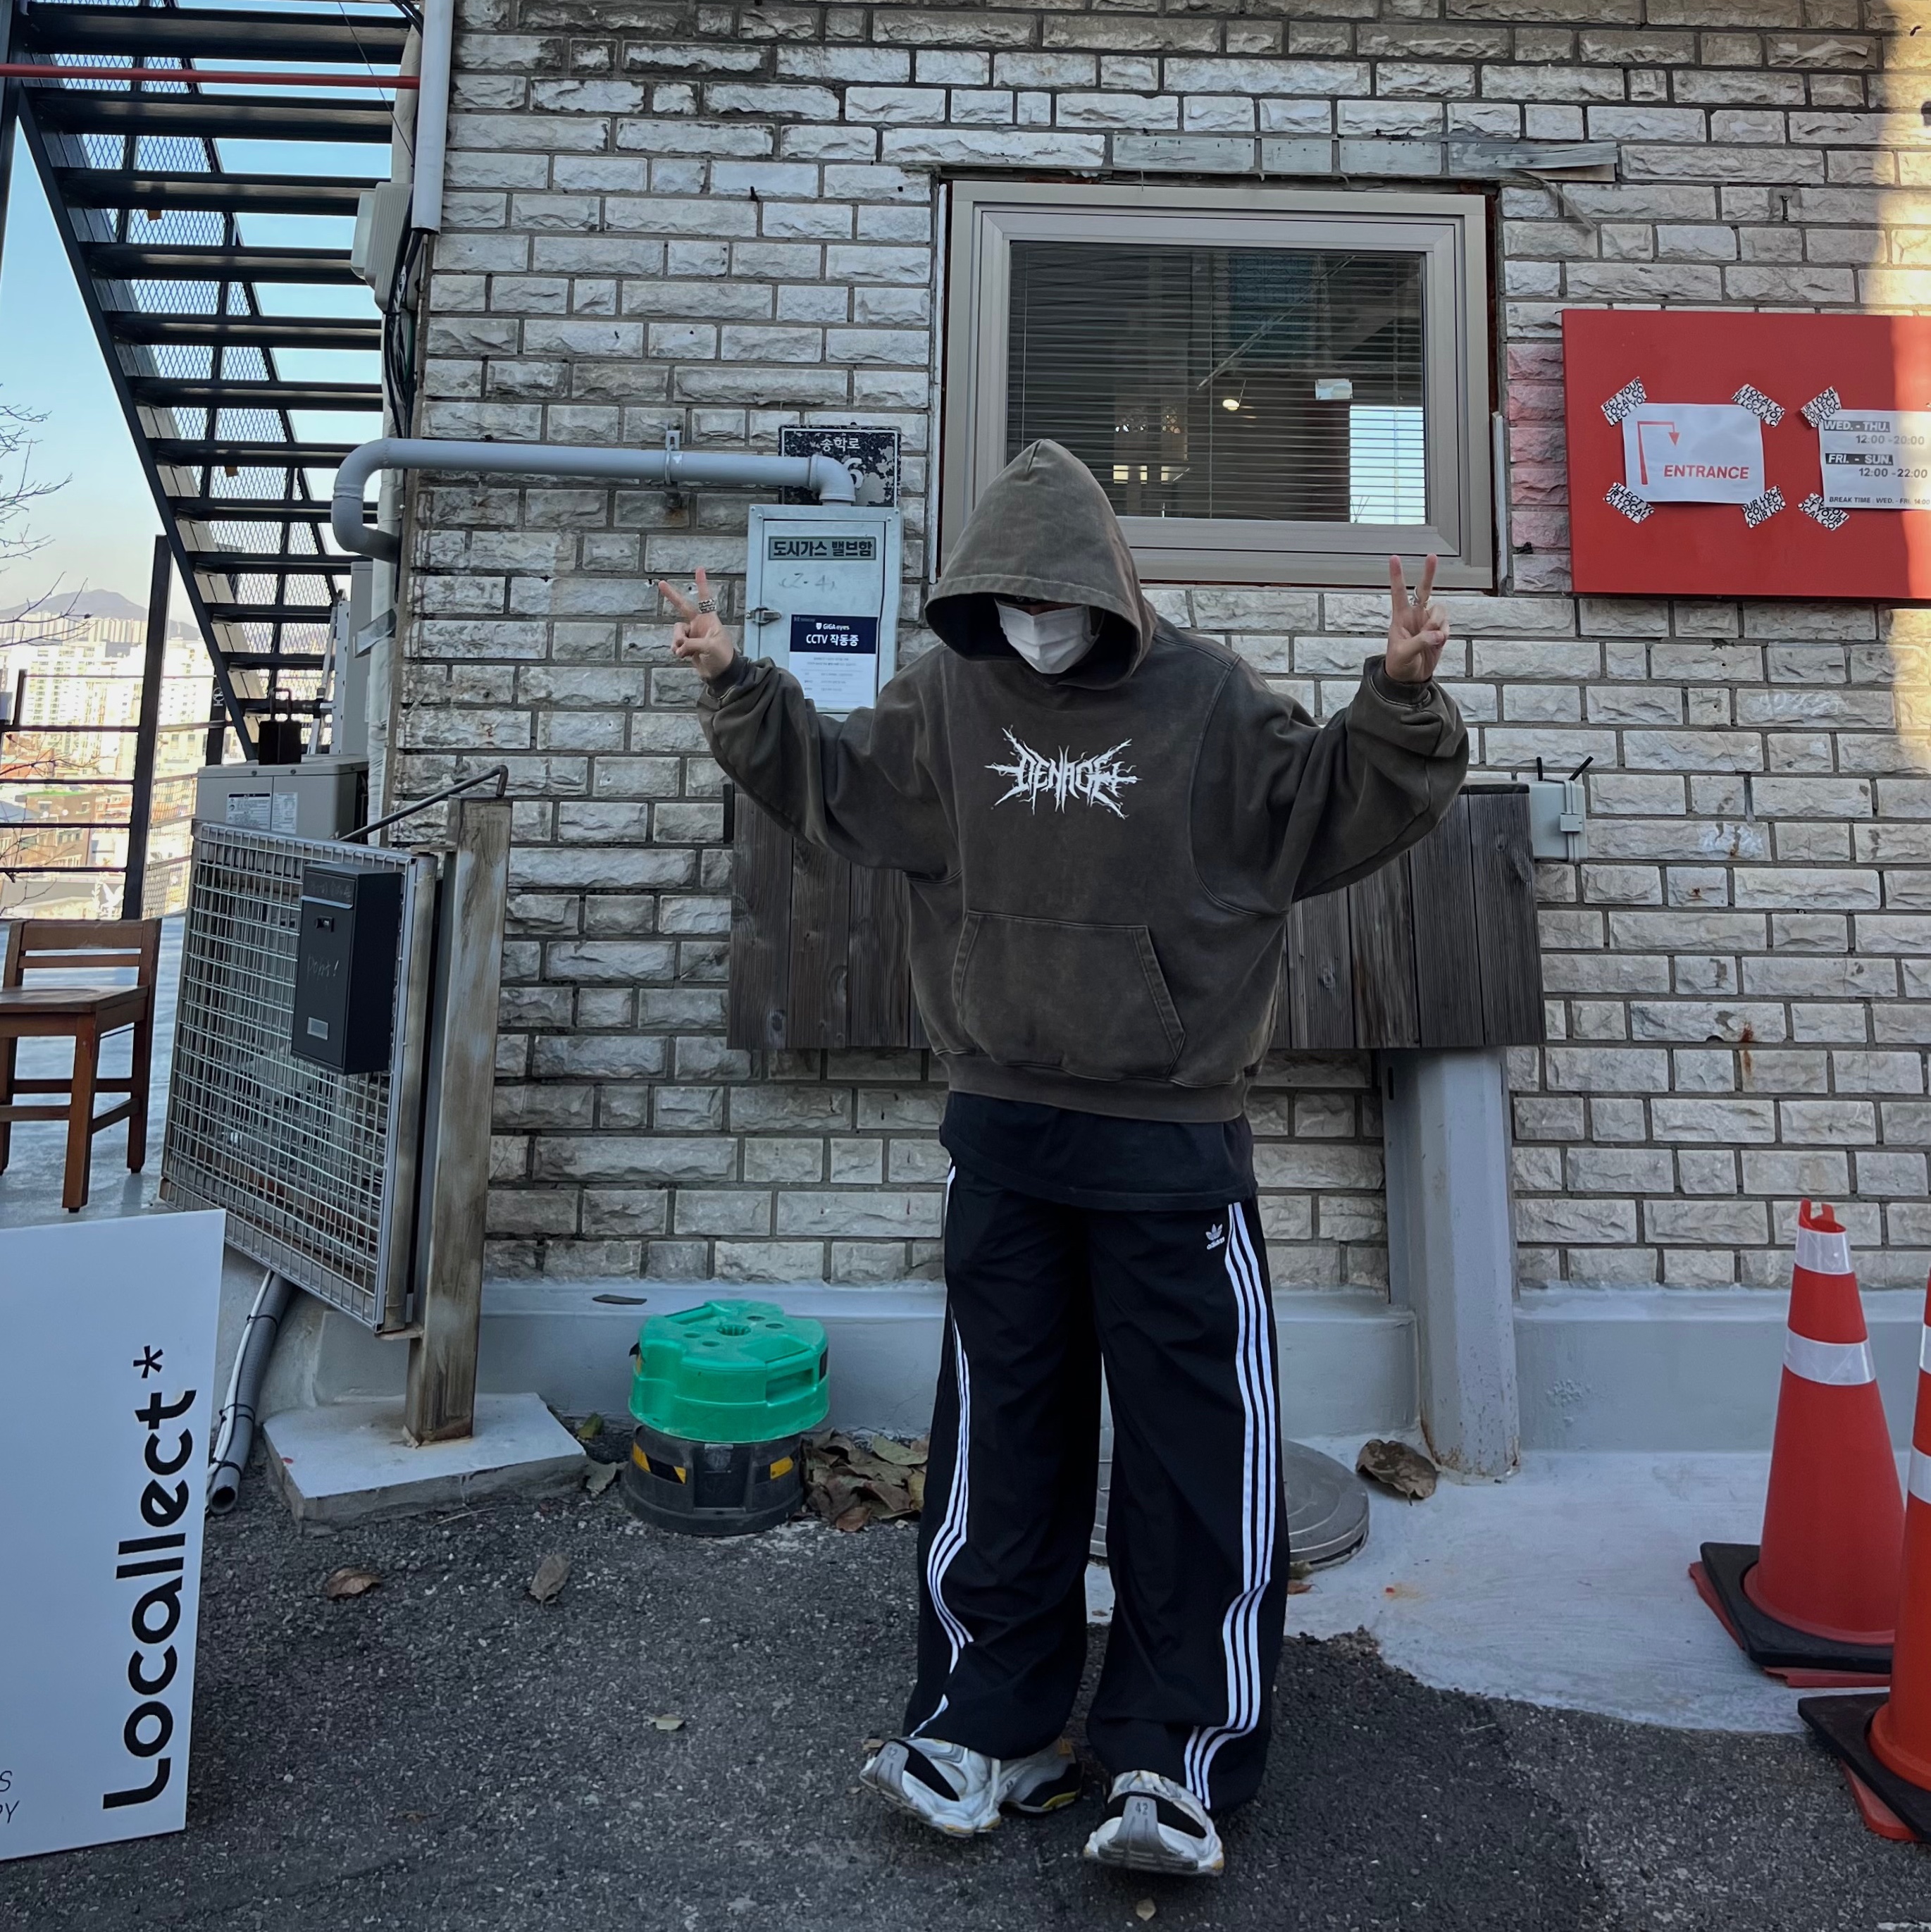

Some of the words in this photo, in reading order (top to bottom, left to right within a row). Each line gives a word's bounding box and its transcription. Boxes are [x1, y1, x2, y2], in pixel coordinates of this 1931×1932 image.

[1603, 395, 1619, 411] ECT
[1737, 389, 1765, 409] LLECT
[1745, 386, 1773, 408] LOCAL
[1606, 396, 1632, 419] LOCAL
[1740, 400, 1768, 421] LOCAL
[1823, 402, 1841, 418] LOC
[1824, 421, 1854, 430] WED.
[1863, 421, 1889, 431] THU.
[820, 437, 861, 452] 송학로
[1856, 435, 1885, 444] 12:00
[1827, 454, 1849, 463] FRI.
[1865, 454, 1892, 464] SUN.
[1663, 464, 1749, 479] ENTRANCE
[1858, 468, 1888, 477] 12:00
[1618, 495, 1646, 519] LOCAL
[1747, 492, 1783, 519] COLLECT
[1817, 505, 1842, 526] YOUR
[1821, 518, 1836, 530] CO
[774, 540, 828, 557] 도시가스
[831, 540, 873, 557] 밸브함
[806, 633, 828, 645] CCTV
[829, 633, 859, 647] 작동중
